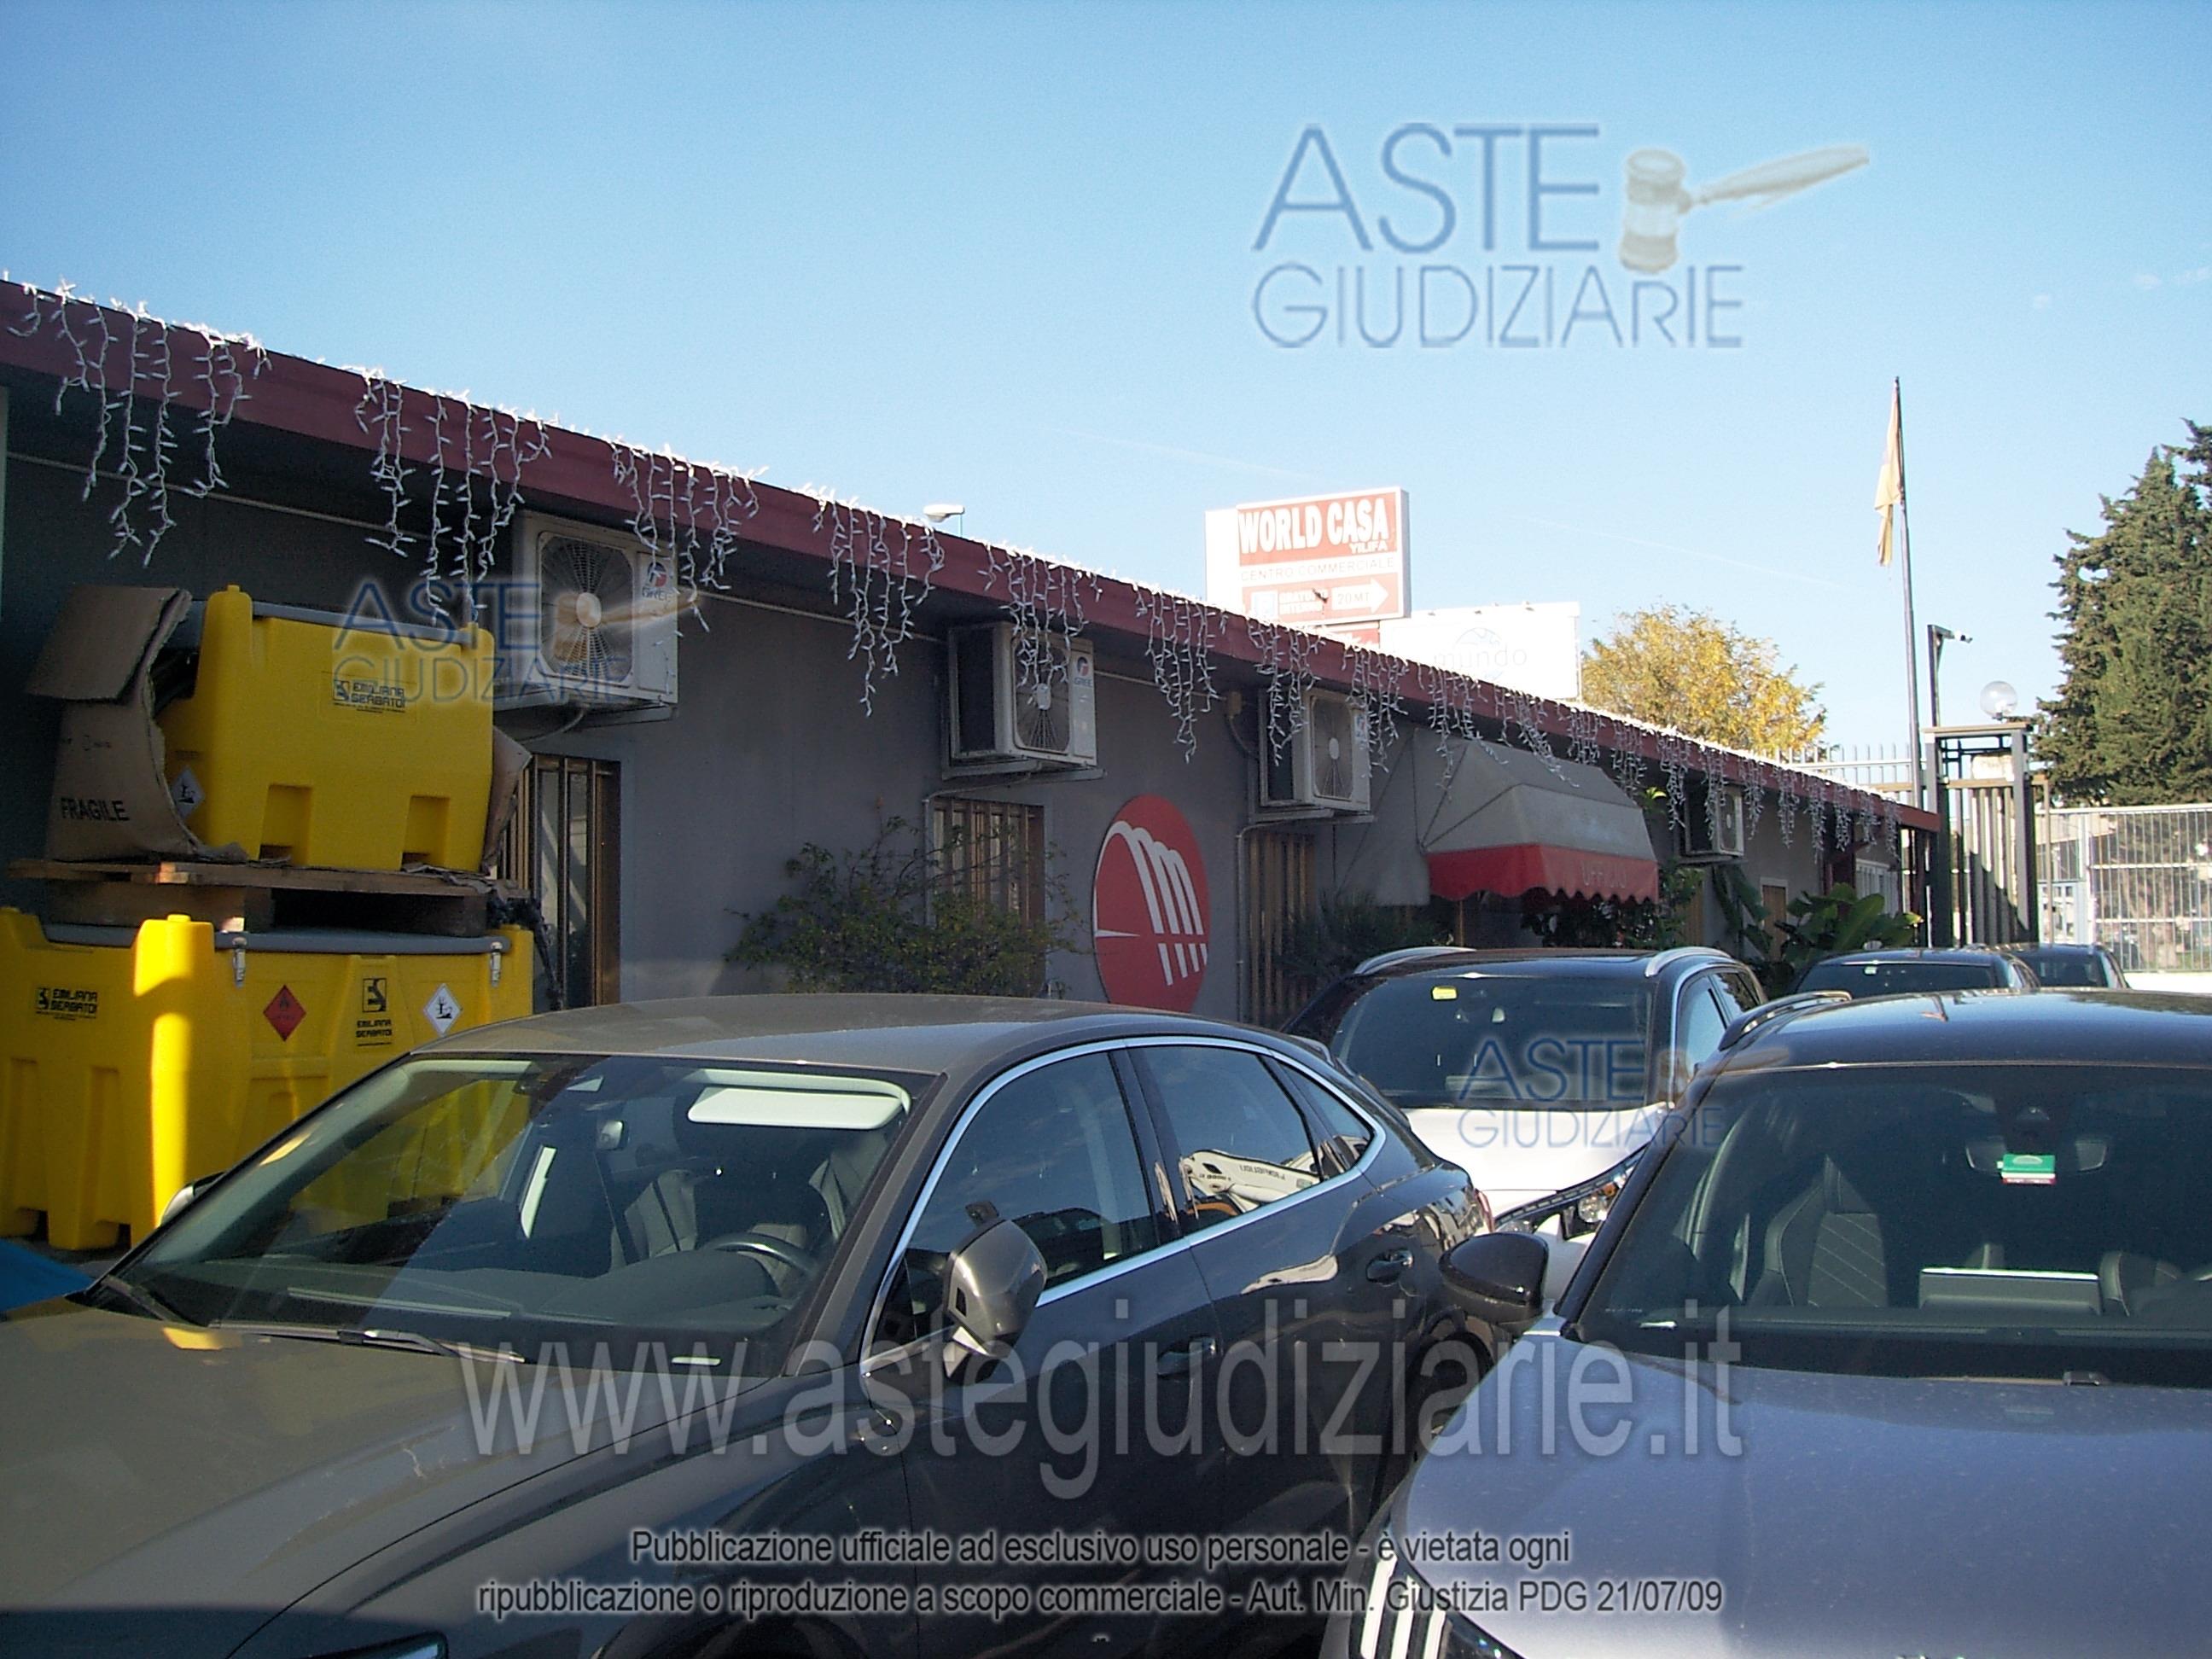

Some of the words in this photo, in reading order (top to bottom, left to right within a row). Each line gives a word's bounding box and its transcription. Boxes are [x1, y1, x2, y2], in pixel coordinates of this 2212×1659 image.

[1238, 505, 1323, 554] WORLD
[1327, 498, 1389, 546] CASA
[1241, 567, 1294, 581] CENTRO
[1299, 557, 1394, 576] COMMERCIALE
[61, 797, 130, 821] FRAGILE
